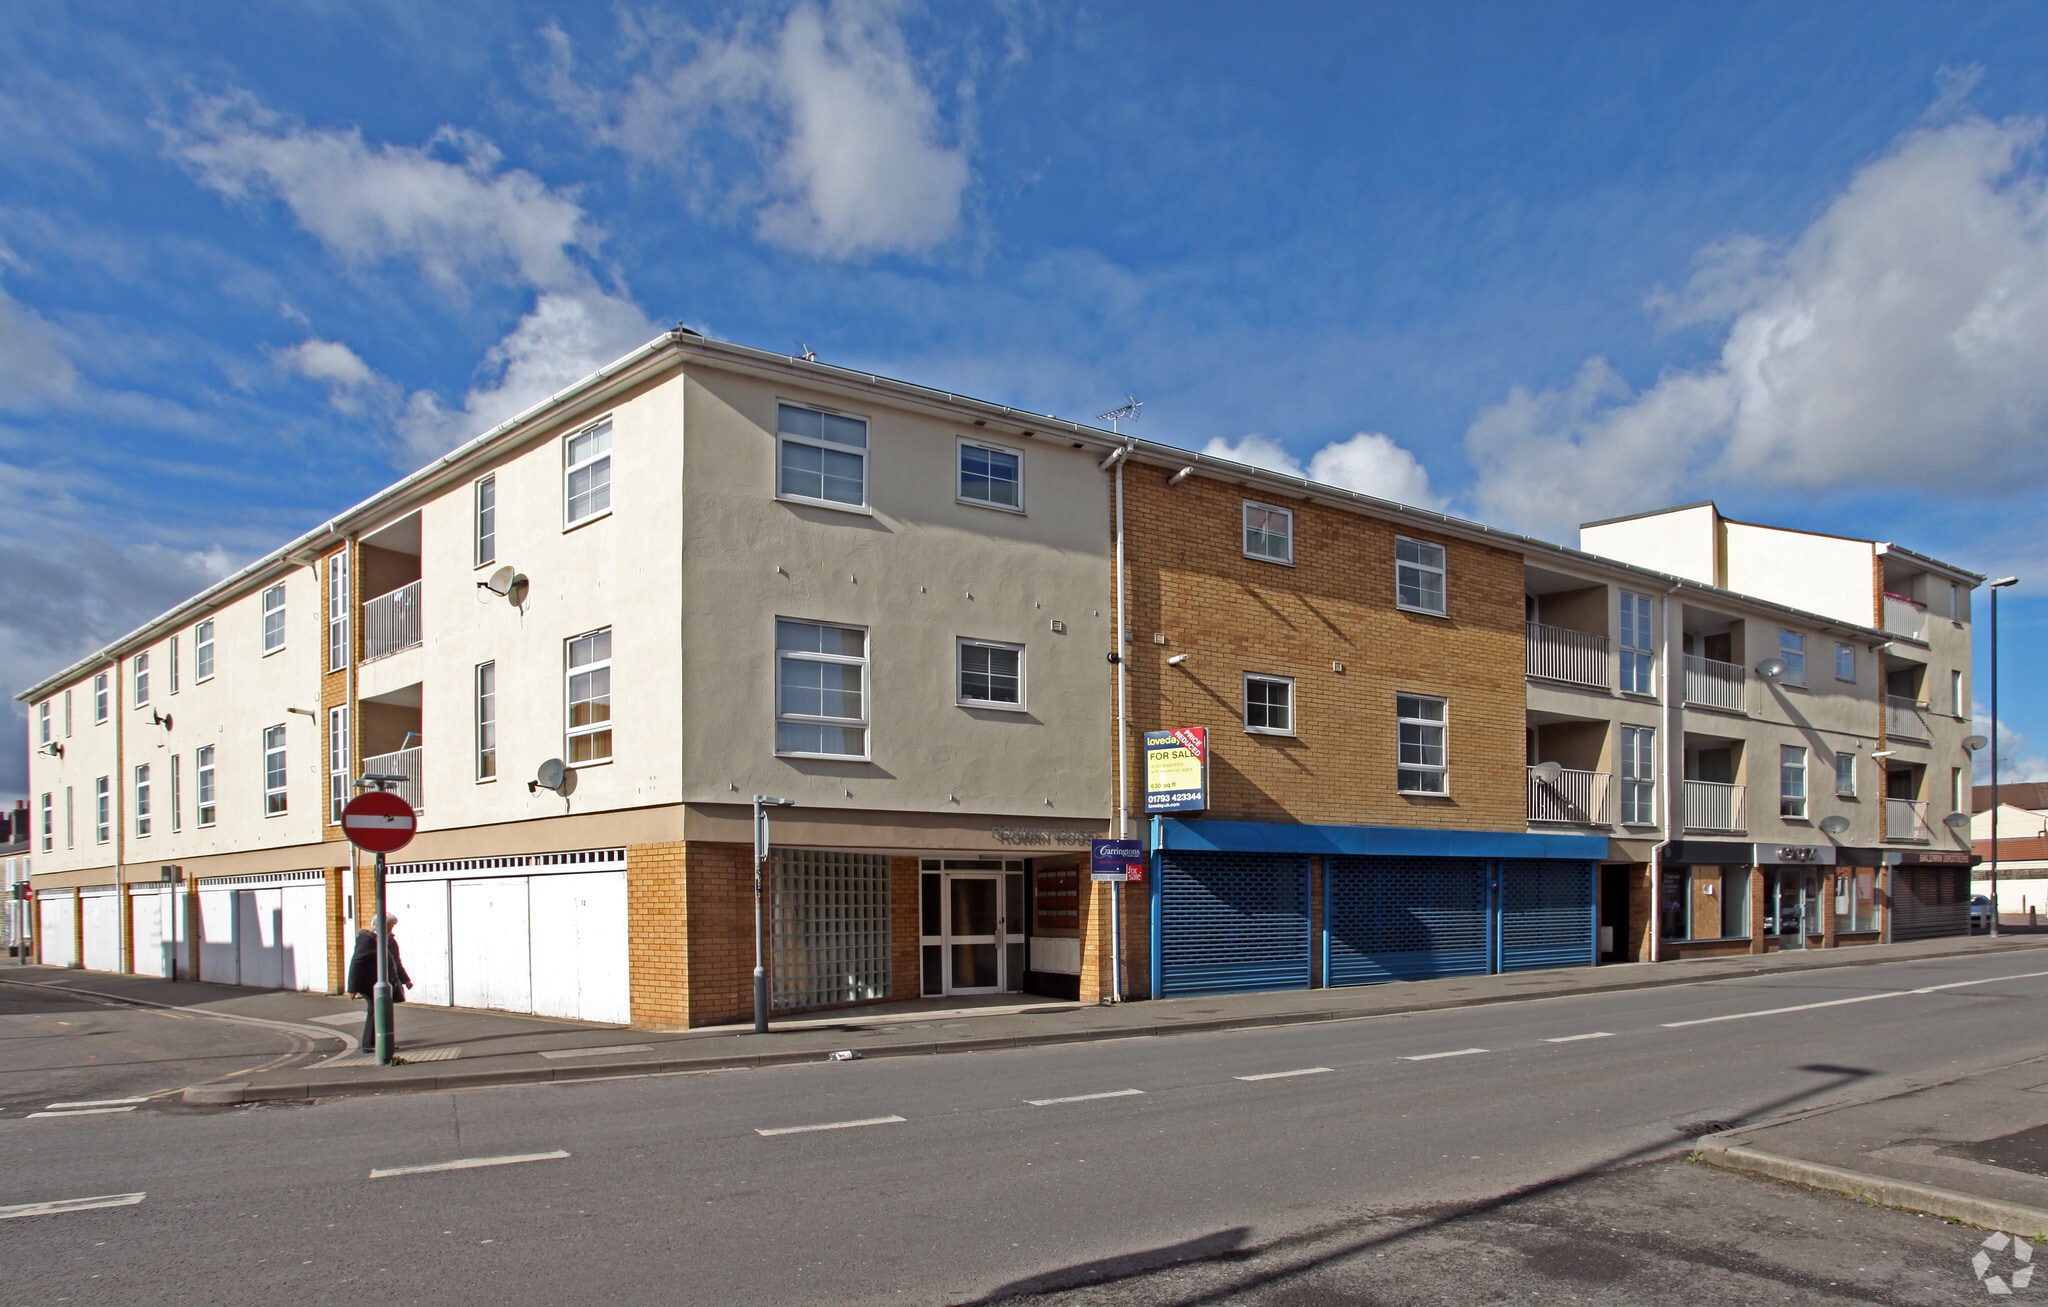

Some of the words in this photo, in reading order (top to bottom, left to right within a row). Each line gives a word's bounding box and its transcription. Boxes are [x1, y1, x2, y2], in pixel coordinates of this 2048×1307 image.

[1174, 730, 1201, 757] REDUCED
[1183, 729, 1202, 747] PRICE
[1150, 752, 1169, 760] FOR
[1148, 794, 1170, 803] 01793
[1171, 792, 1202, 801] 423344
[992, 826, 1051, 847] ROWAN
[1099, 844, 1141, 858] Carringtons
[1128, 865, 1138, 874] for
[1128, 872, 1142, 881] sale
